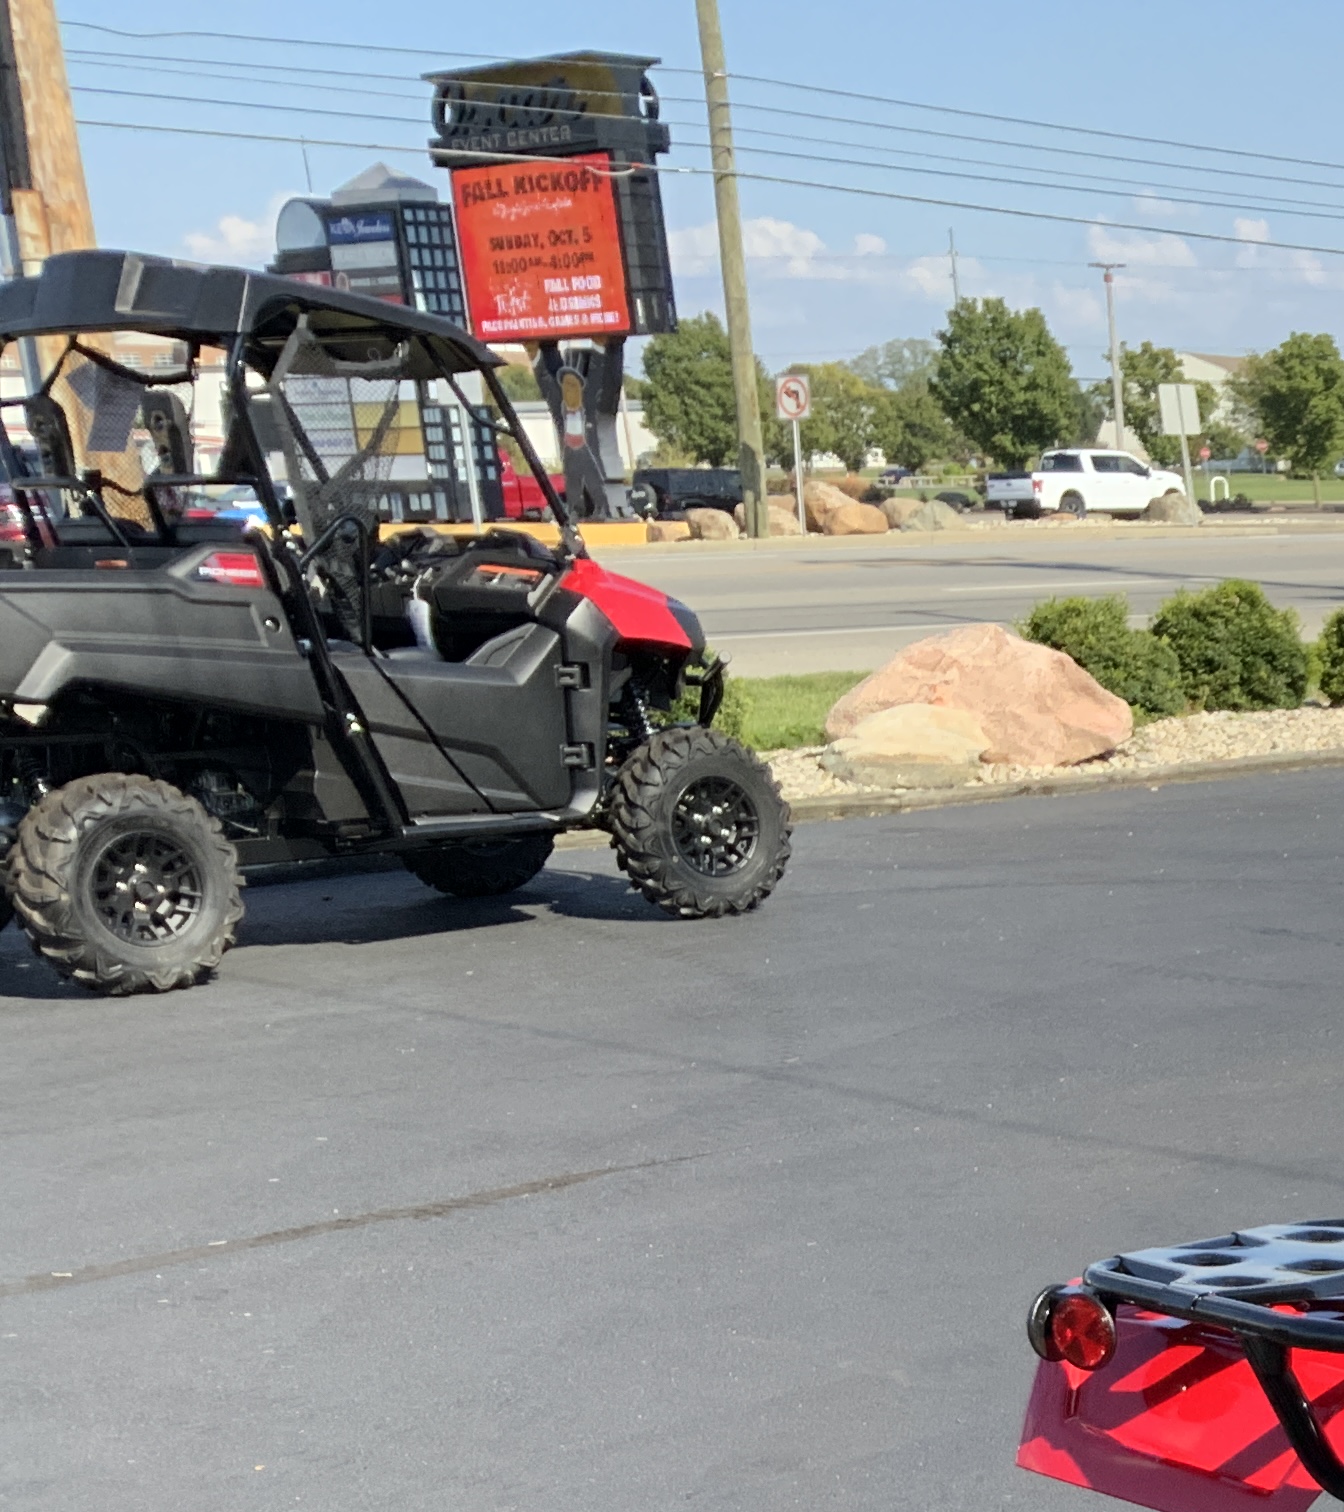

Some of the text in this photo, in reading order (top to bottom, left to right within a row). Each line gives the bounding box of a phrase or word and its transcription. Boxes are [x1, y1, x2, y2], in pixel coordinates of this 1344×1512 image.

[506, 125, 573, 147] CENTER
[460, 168, 604, 208] FALL KICKOFF
[582, 226, 592, 244] 5
